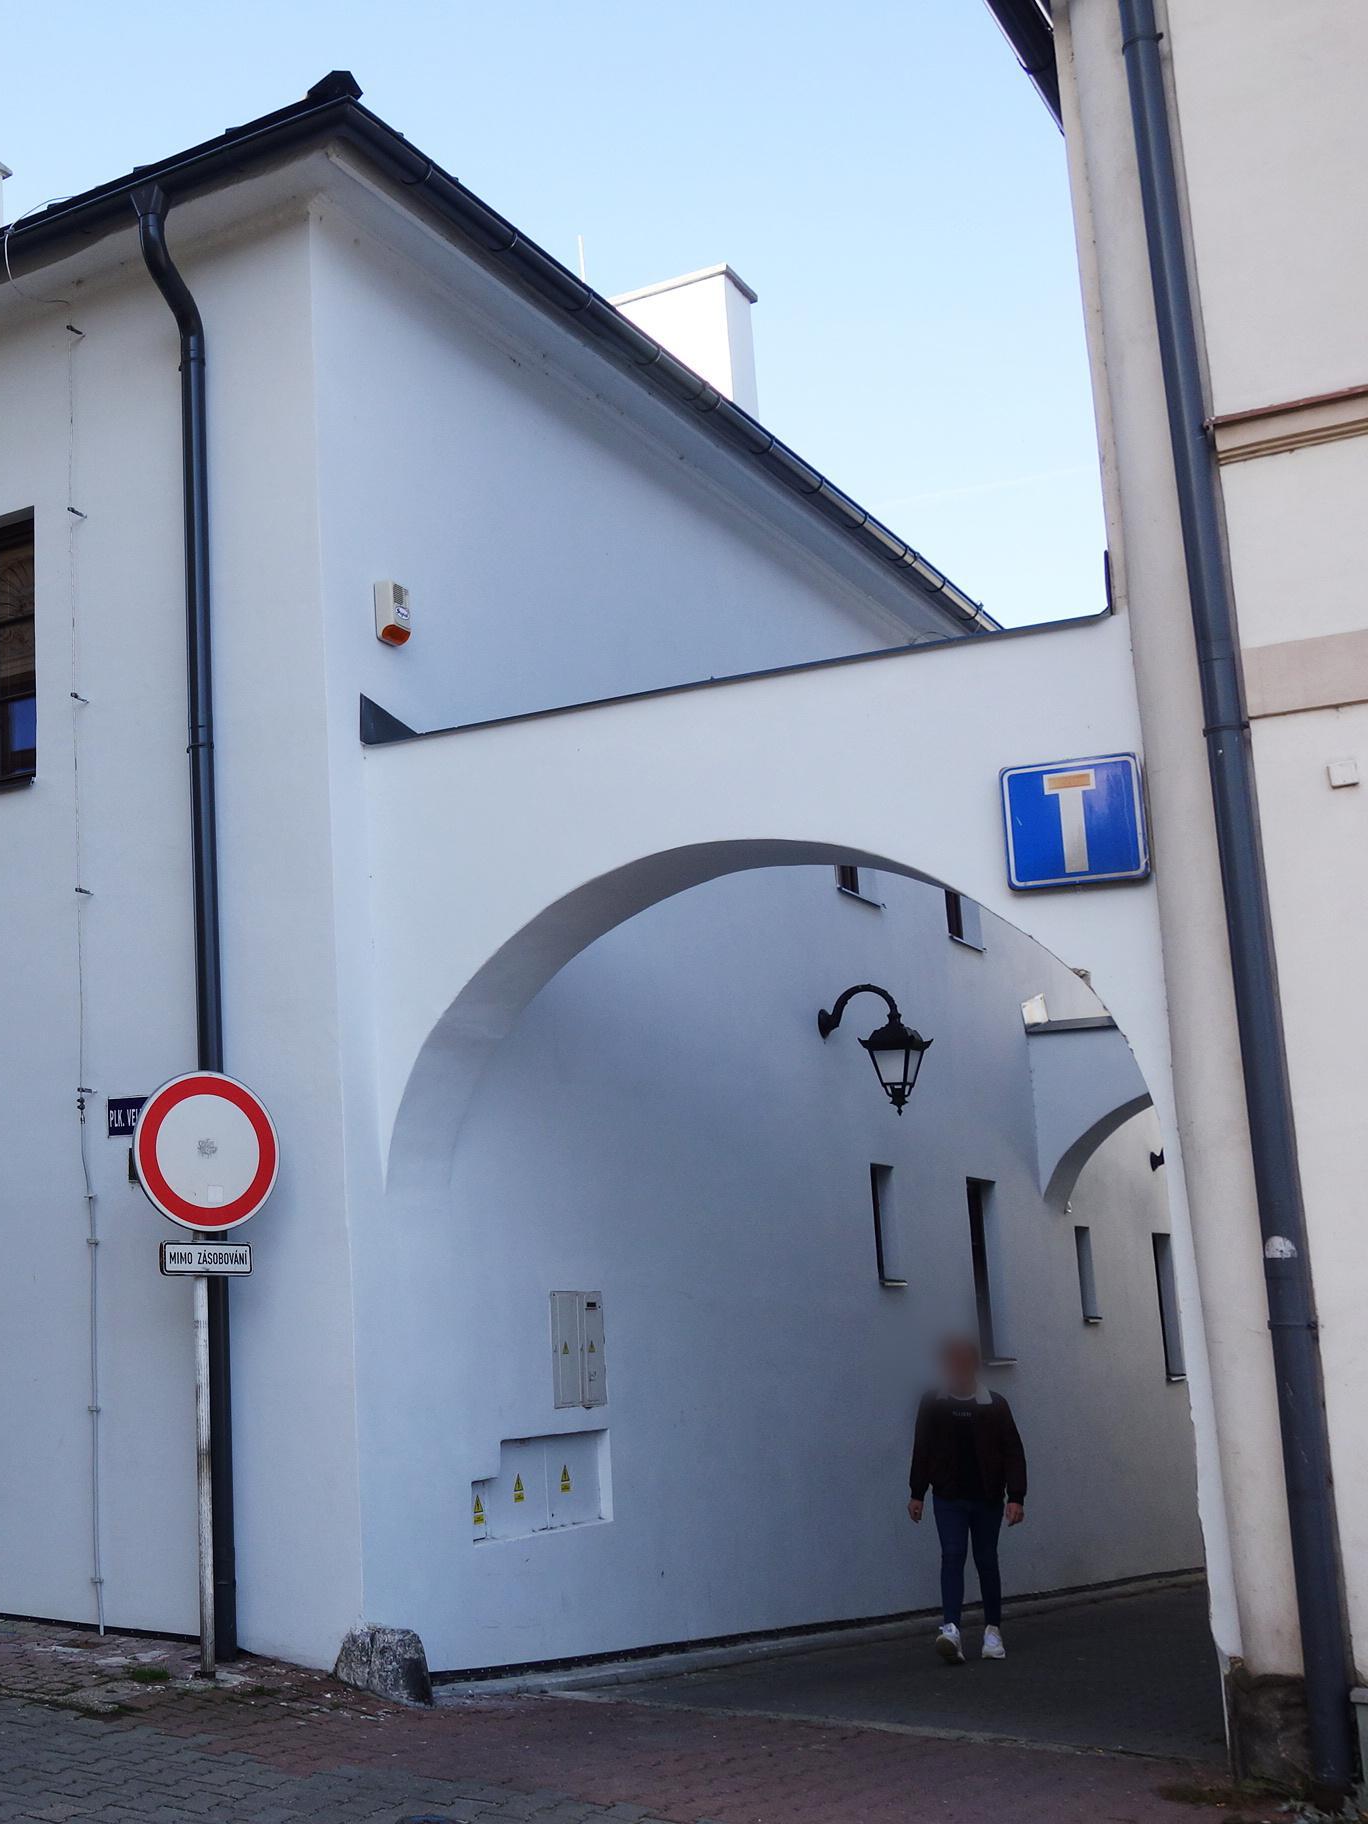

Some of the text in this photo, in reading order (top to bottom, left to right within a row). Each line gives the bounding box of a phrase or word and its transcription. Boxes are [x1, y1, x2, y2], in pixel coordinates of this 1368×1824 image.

[109, 1109, 125, 1128] PLK.
[169, 1249, 248, 1265] MIMO ZÁSOBOVÁNÍ
